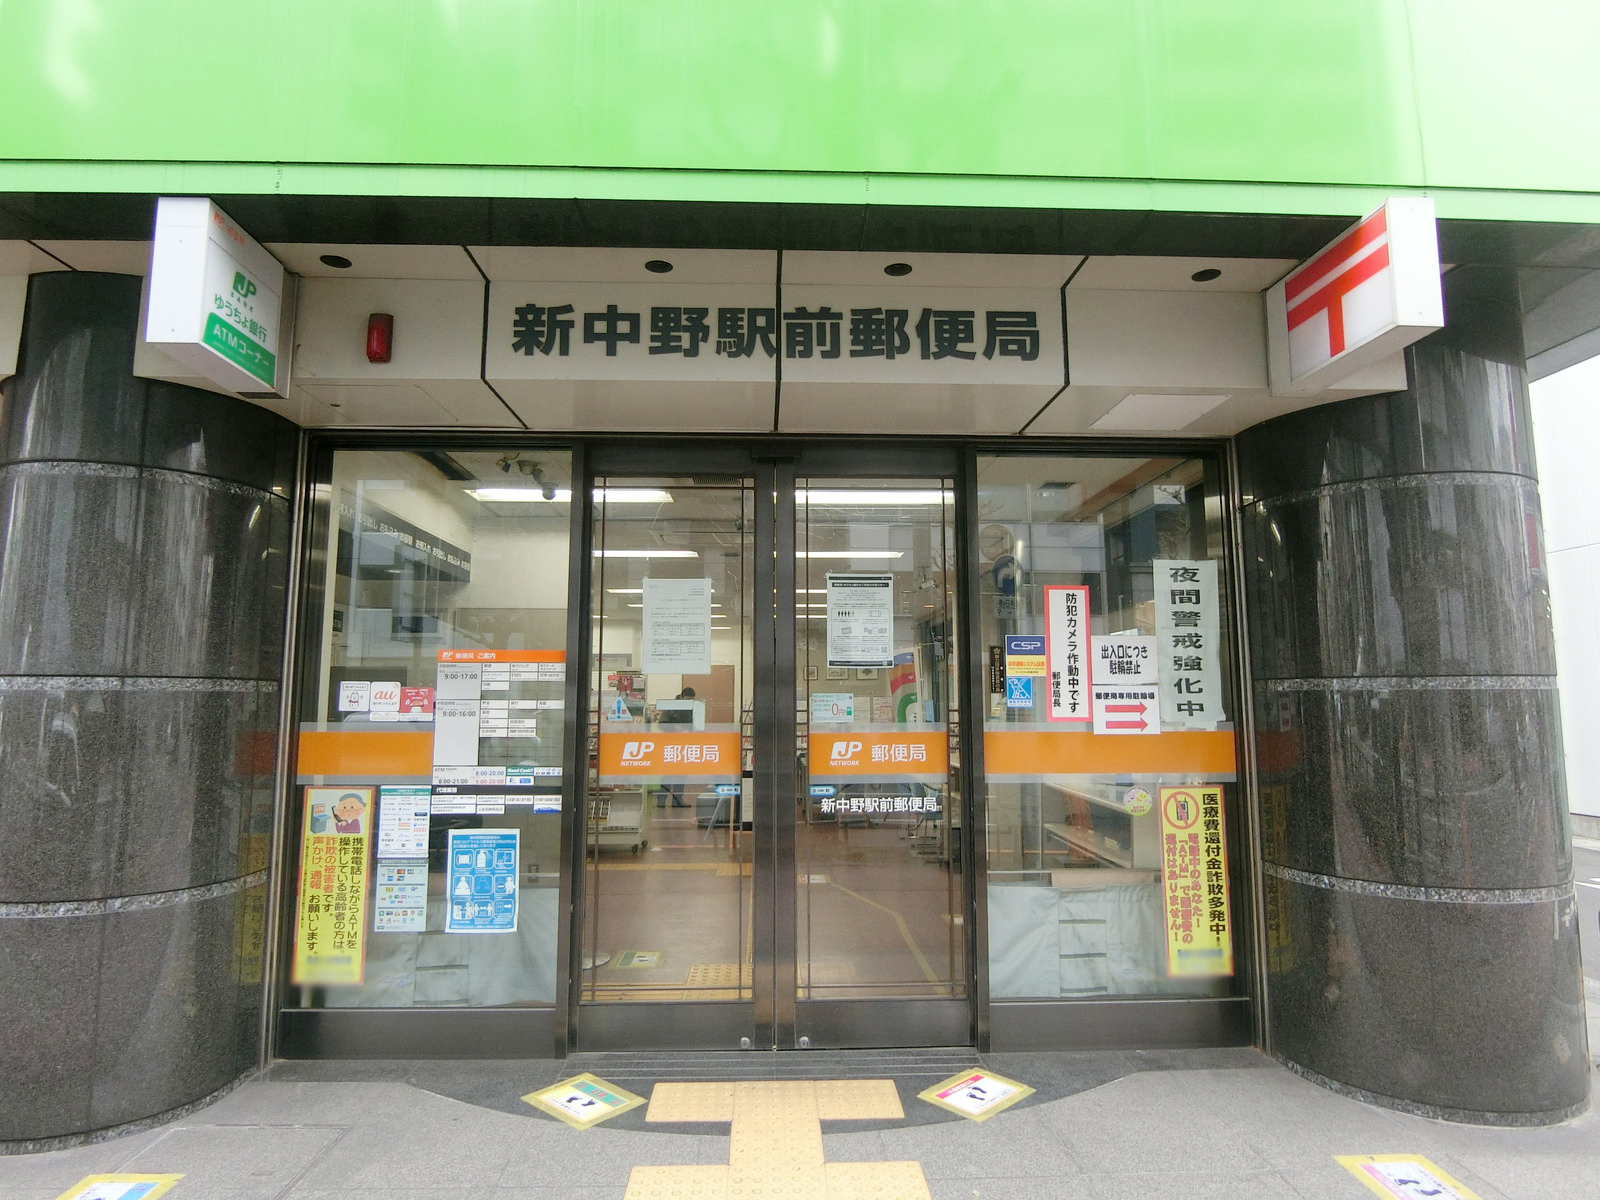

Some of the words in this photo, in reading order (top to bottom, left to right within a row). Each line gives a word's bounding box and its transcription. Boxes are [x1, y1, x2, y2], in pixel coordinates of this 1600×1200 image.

[214, 293, 267, 343] ゆうちょ銀行
[512, 304, 1040, 362] 新中野駅前郵便局
[213, 324, 270, 367] ATMコーナー
[1010, 641, 1041, 650] CSP
[1168, 566, 1205, 718] 夜間警戒強化中
[1065, 592, 1080, 714] 防犯カメラ作動中です
[1101, 644, 1148, 659] 出入口につき
[1109, 660, 1142, 675] 駐輪禁止
[374, 691, 397, 700] au
[1051, 671, 1061, 708] 郵便局長
[622, 742, 655, 760] JP
[663, 745, 720, 763] 郵便局
[830, 742, 863, 760] JP
[871, 744, 927, 762] 郵便局
[820, 797, 938, 814] 新中野駅前郵便局
[322, 837, 337, 917] 詐欺の被害者です。
[346, 837, 364, 949] 携帯電話しながらATMを
